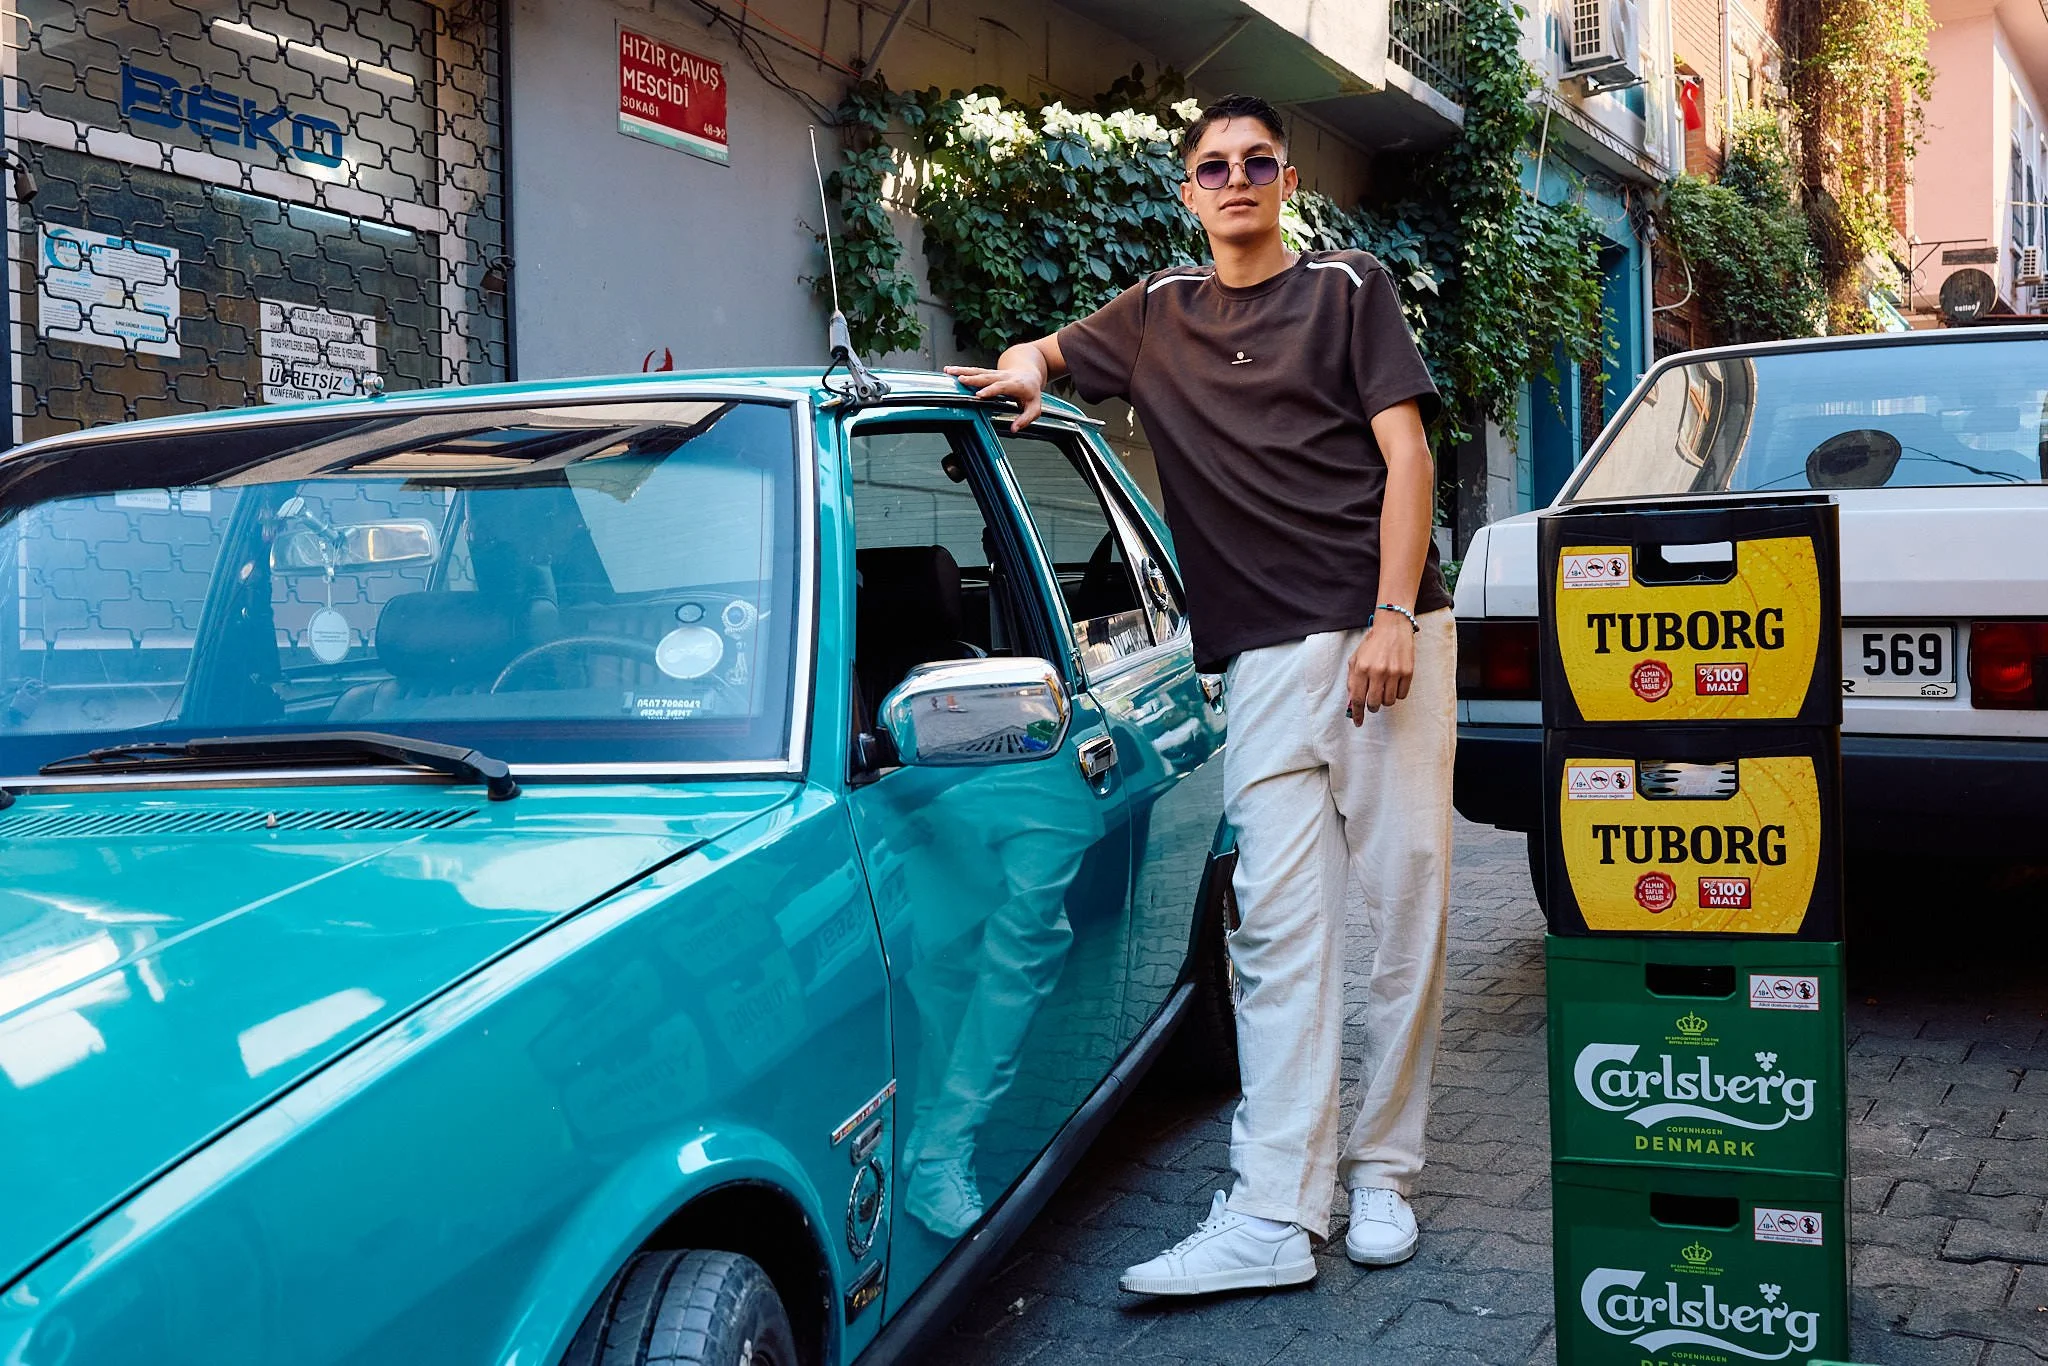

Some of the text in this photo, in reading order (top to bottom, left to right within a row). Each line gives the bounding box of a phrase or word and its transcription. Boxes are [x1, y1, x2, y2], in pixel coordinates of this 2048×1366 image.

[623, 35, 719, 91] HIZIR ÇAVUŞ
[623, 67, 689, 108] MESCİDİ
[122, 64, 343, 168] BEKO
[622, 95, 659, 117] SOKAĞI
[269, 364, 343, 391] ÜCRETSİZ
[270, 388, 305, 401] KONFERANS
[1587, 607, 1785, 654] TUBORG
[1862, 633, 1942, 676] 569
[1700, 667, 1743, 683] %100
[1706, 683, 1739, 692] MALT
[1592, 824, 1787, 866] TUBORG
[1703, 881, 1746, 896] %100
[1710, 896, 1742, 905] MALT
[1574, 1043, 1817, 1121] Carlsberg
[1666, 1126, 1723, 1135] COPENHAGEN
[1635, 1135, 1755, 1157] DENMARK
[1580, 1267, 1820, 1353] Carlsberg
[1671, 1351, 1728, 1363] COPENHAGEN
